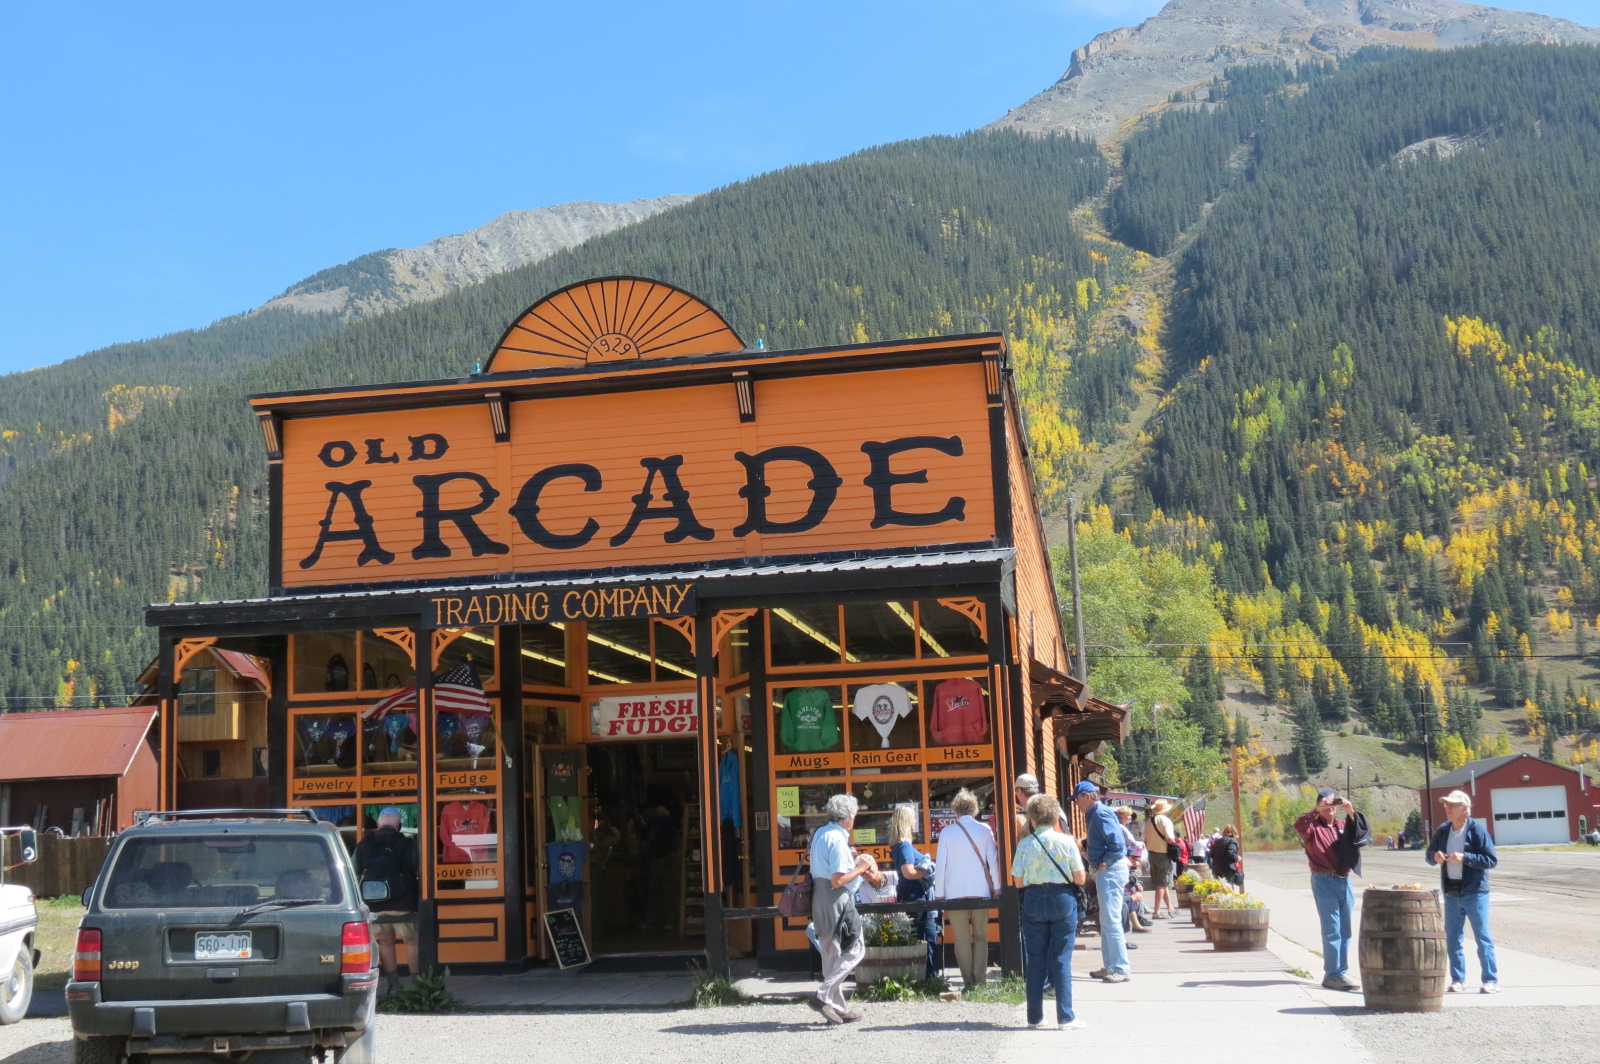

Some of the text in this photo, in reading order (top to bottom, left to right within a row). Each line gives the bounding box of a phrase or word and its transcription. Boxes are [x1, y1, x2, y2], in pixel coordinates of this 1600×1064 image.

[592, 337, 632, 357] 1929
[317, 433, 450, 468] OLD
[299, 435, 966, 570] ARCADE
[431, 583, 692, 626] TRADING COMPANY
[617, 699, 694, 718] FRESH
[852, 751, 919, 764] Rain Gear
[943, 748, 980, 759] Hats
[790, 756, 830, 768] Mugs
[298, 779, 353, 791] Jewelry
[372, 773, 488, 788] Fresh Fudge
[108, 960, 140, 970] Jeep
